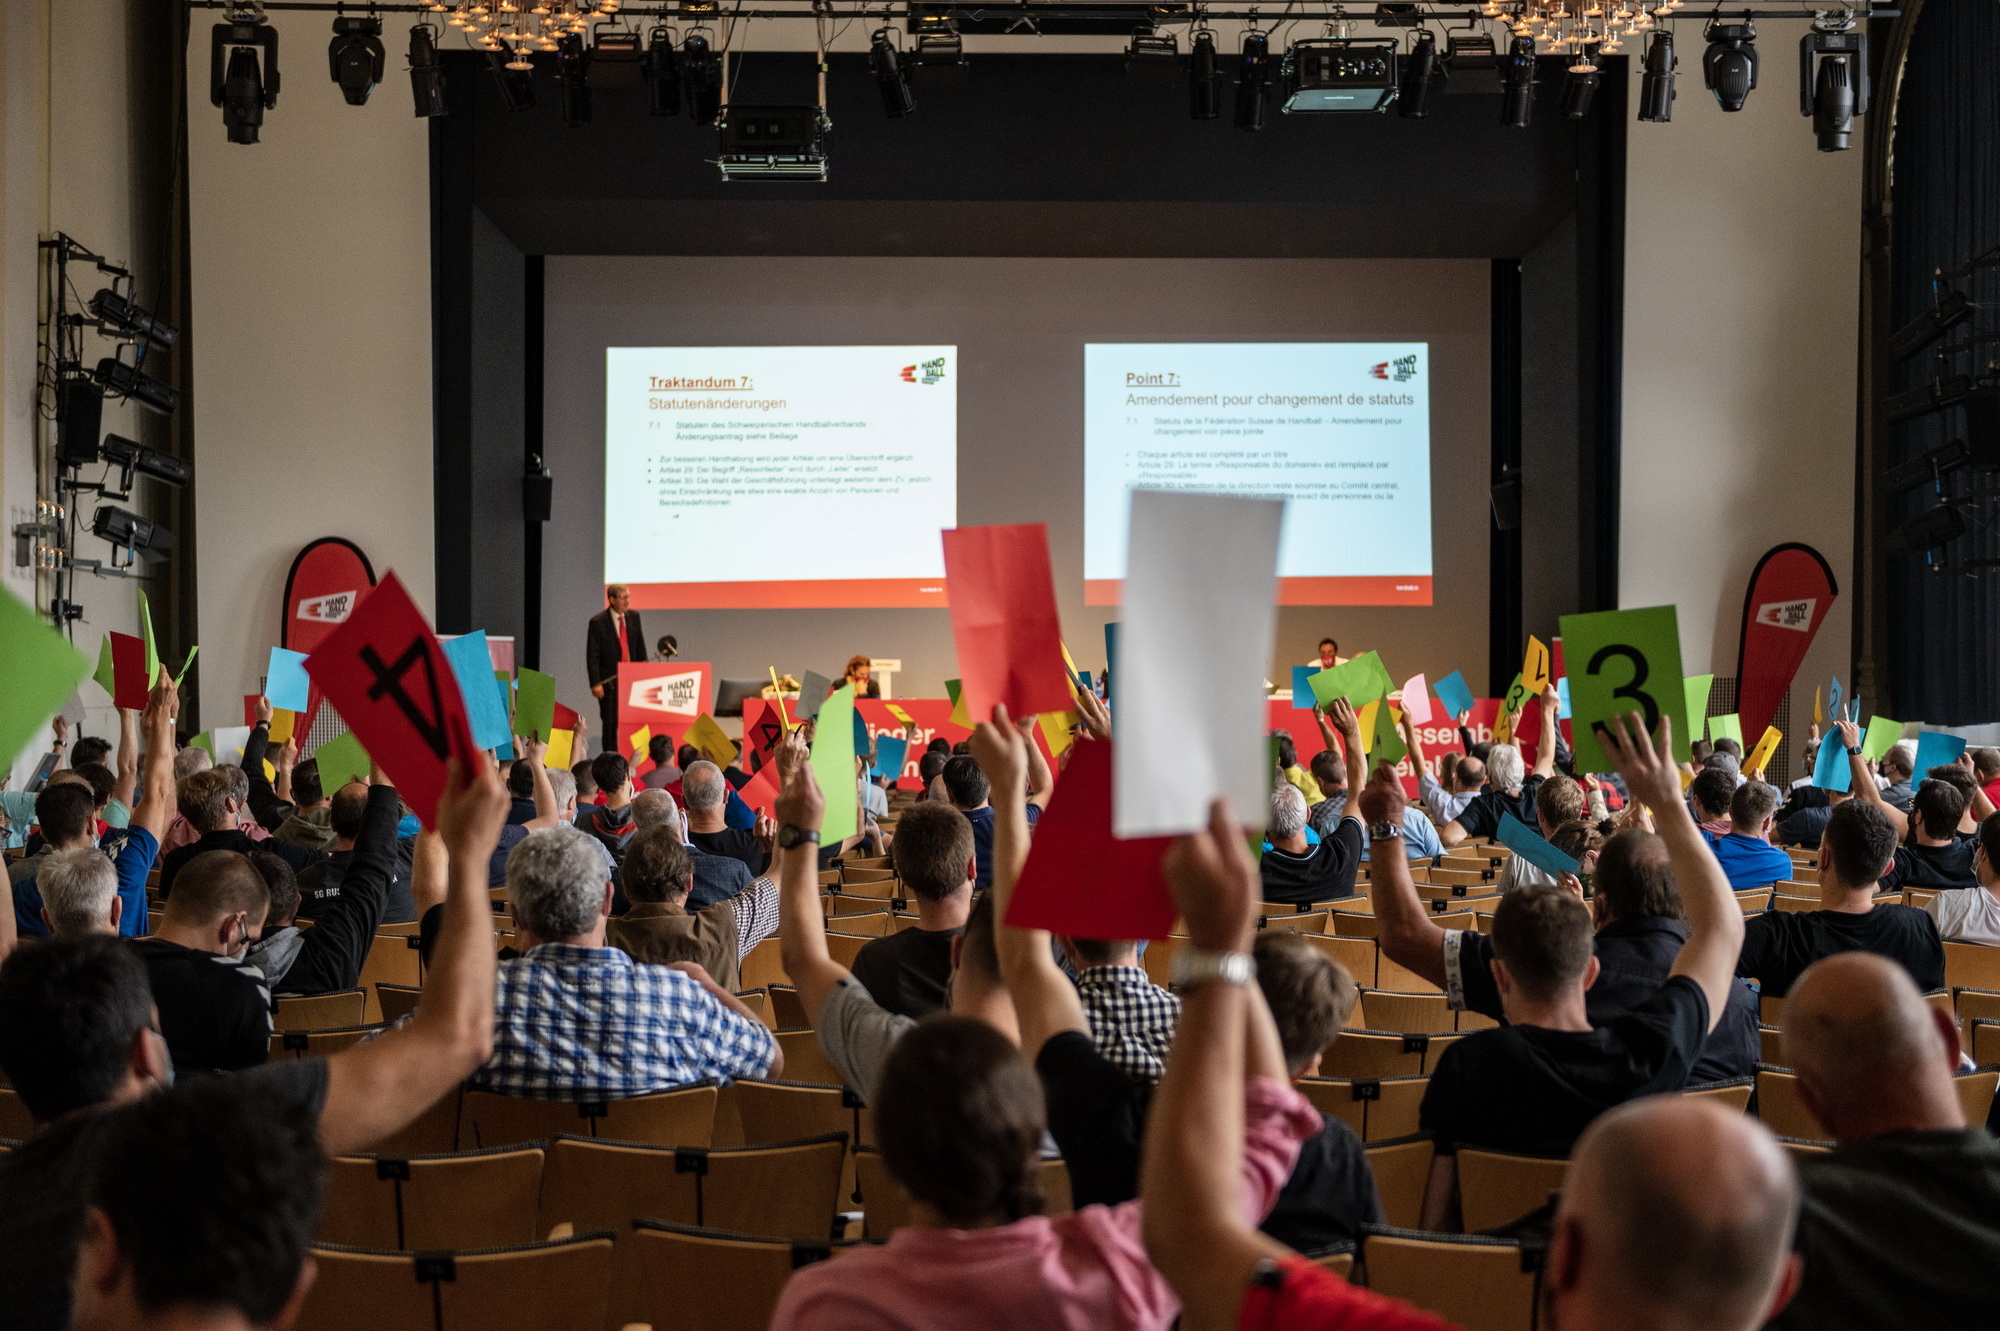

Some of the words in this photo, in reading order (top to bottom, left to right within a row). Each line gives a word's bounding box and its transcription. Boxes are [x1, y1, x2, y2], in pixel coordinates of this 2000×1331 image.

[921, 357, 946, 369] HAND
[1392, 354, 1417, 366] HAND
[926, 368, 946, 377] BALL
[1397, 364, 1418, 374] BALL
[648, 376, 737, 389] Traktandum
[740, 376, 754, 389] 7:
[1126, 372, 1164, 385] Point
[1167, 372, 1181, 385] 7:
[648, 397, 788, 411] Statutenänderungen
[1126, 393, 1219, 406] Amendement
[1221, 393, 1254, 408] pour
[1257, 393, 1343, 408] changement
[1346, 393, 1365, 406] de
[1368, 393, 1415, 406] statuts
[676, 421, 709, 429] Statuten
[711, 421, 726, 429] des
[728, 421, 794, 429] Schweizerischen
[1154, 417, 1181, 425] Statuts
[1183, 417, 1194, 425] de
[1195, 417, 1203, 425] la
[1248, 417, 1274, 425] Suisse
[1276, 417, 1287, 425] de
[1288, 417, 1323, 425] Handball
[1330, 417, 1383, 425] Amendement
[1385, 417, 1403, 426] pour
[1154, 428, 1202, 437] changement
[1204, 428, 1218, 436] voir
[1195, 450, 1208, 458] est
[325, 595, 348, 606] HAND
[329, 604, 346, 612] BALL
[1785, 602, 1807, 613] HAND
[1789, 611, 1806, 619] BALL
[668, 678, 695, 691] HAND
[360, 636, 449, 761] 4
[672, 689, 695, 699] BALL
[1506, 684, 1525, 713] 3
[1585, 643, 1660, 752] 3
[1829, 687, 1839, 718] 2
[760, 723, 783, 752] 4
[314, 889, 324, 899] SG
